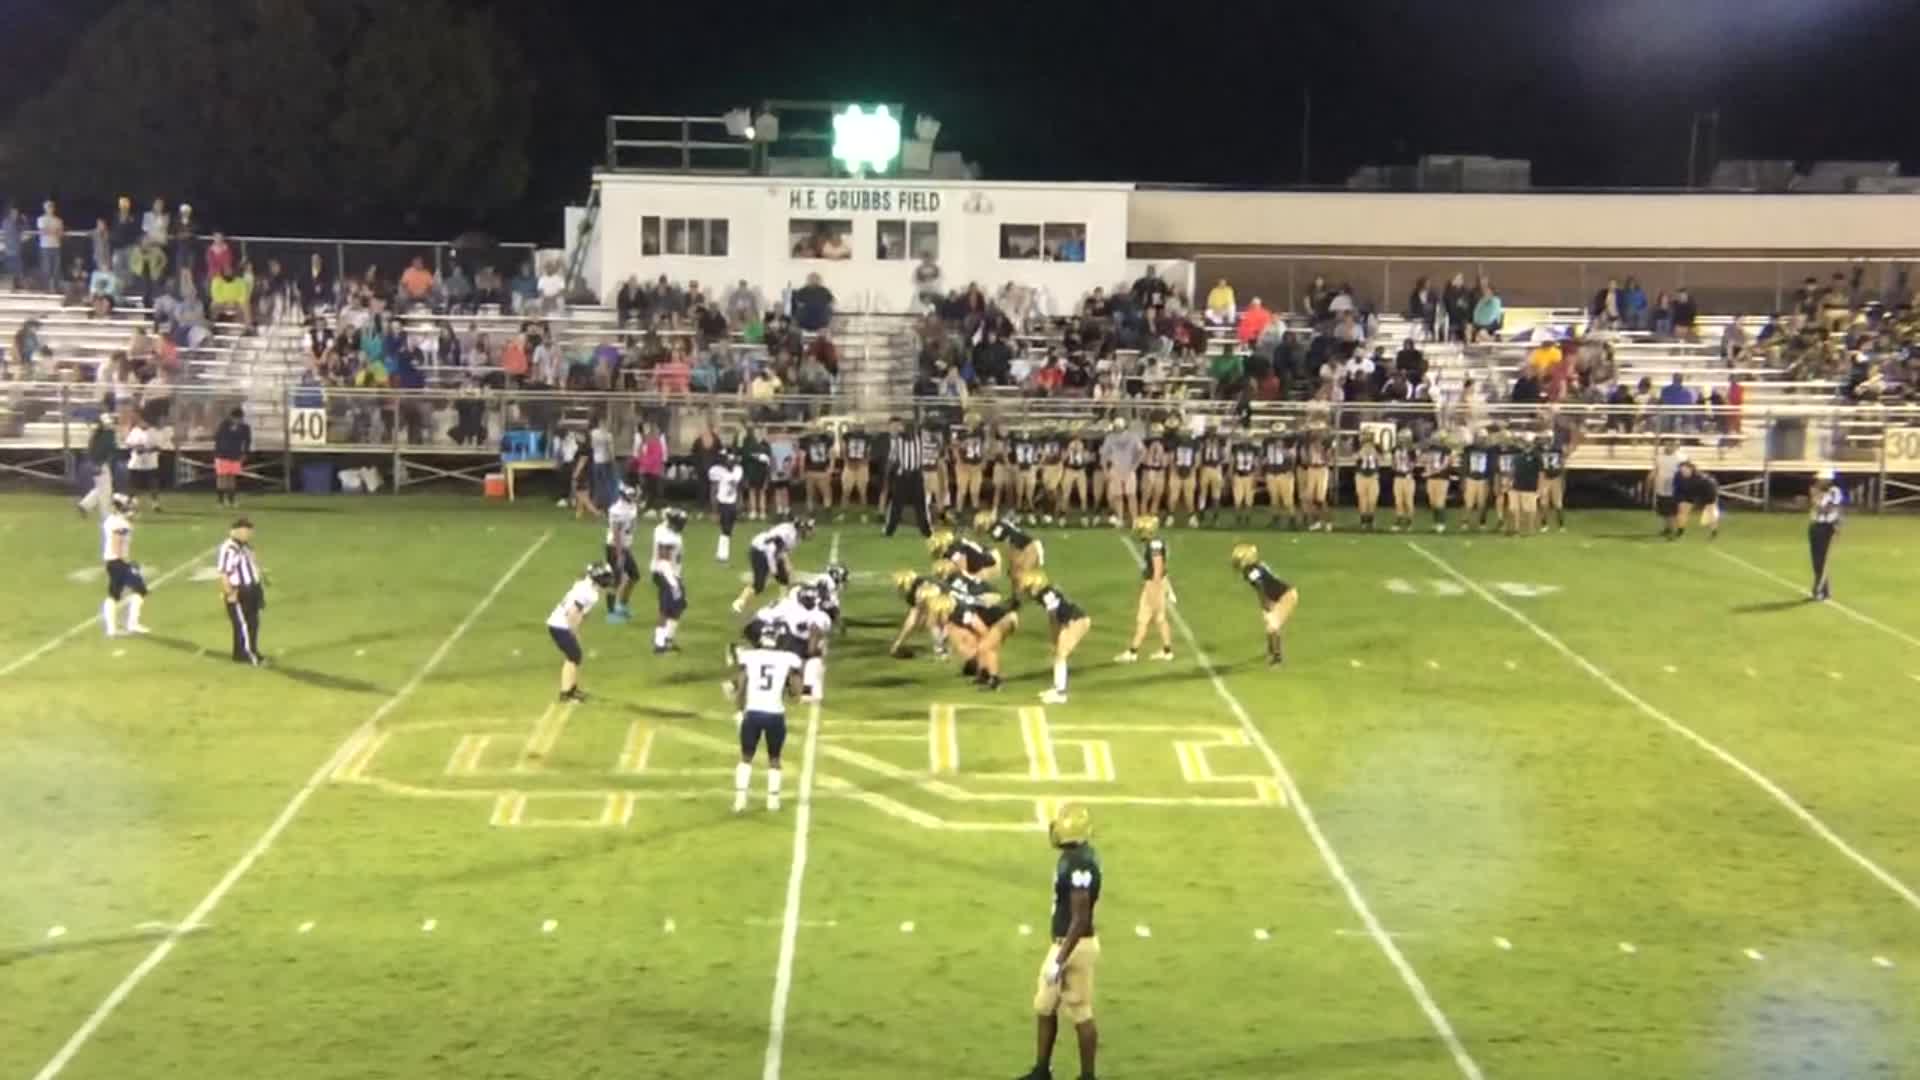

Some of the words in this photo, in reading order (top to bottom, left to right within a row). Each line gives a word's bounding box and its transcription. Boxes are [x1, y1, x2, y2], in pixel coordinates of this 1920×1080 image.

[825, 190, 891, 211] GRUBBS
[899, 191, 940, 213] FIELD
[290, 411, 324, 441] 40
[1888, 432, 1920, 460] 30
[760, 664, 776, 691] 5
